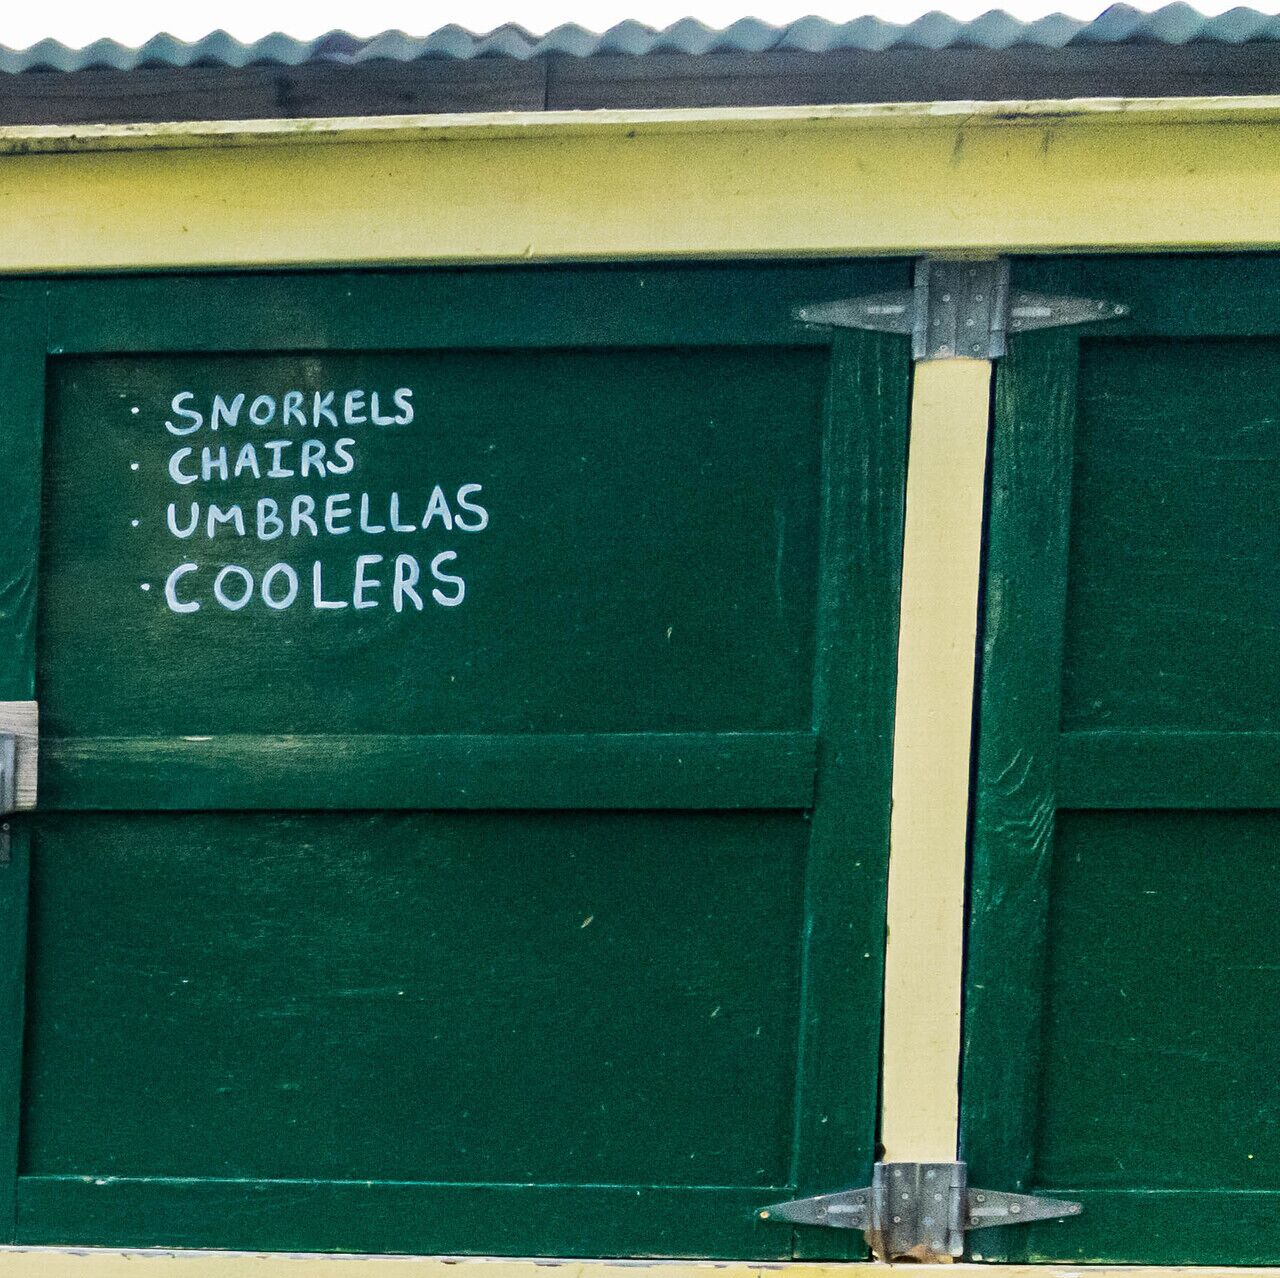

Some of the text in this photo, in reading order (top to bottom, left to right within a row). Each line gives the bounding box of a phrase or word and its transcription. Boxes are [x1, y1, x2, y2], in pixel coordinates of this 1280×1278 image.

[164, 387, 415, 435] SNORKELS
[168, 437, 356, 485] CHAIRS
[167, 483, 489, 541] UMBRELLAS
[164, 550, 466, 613] COOLERS
